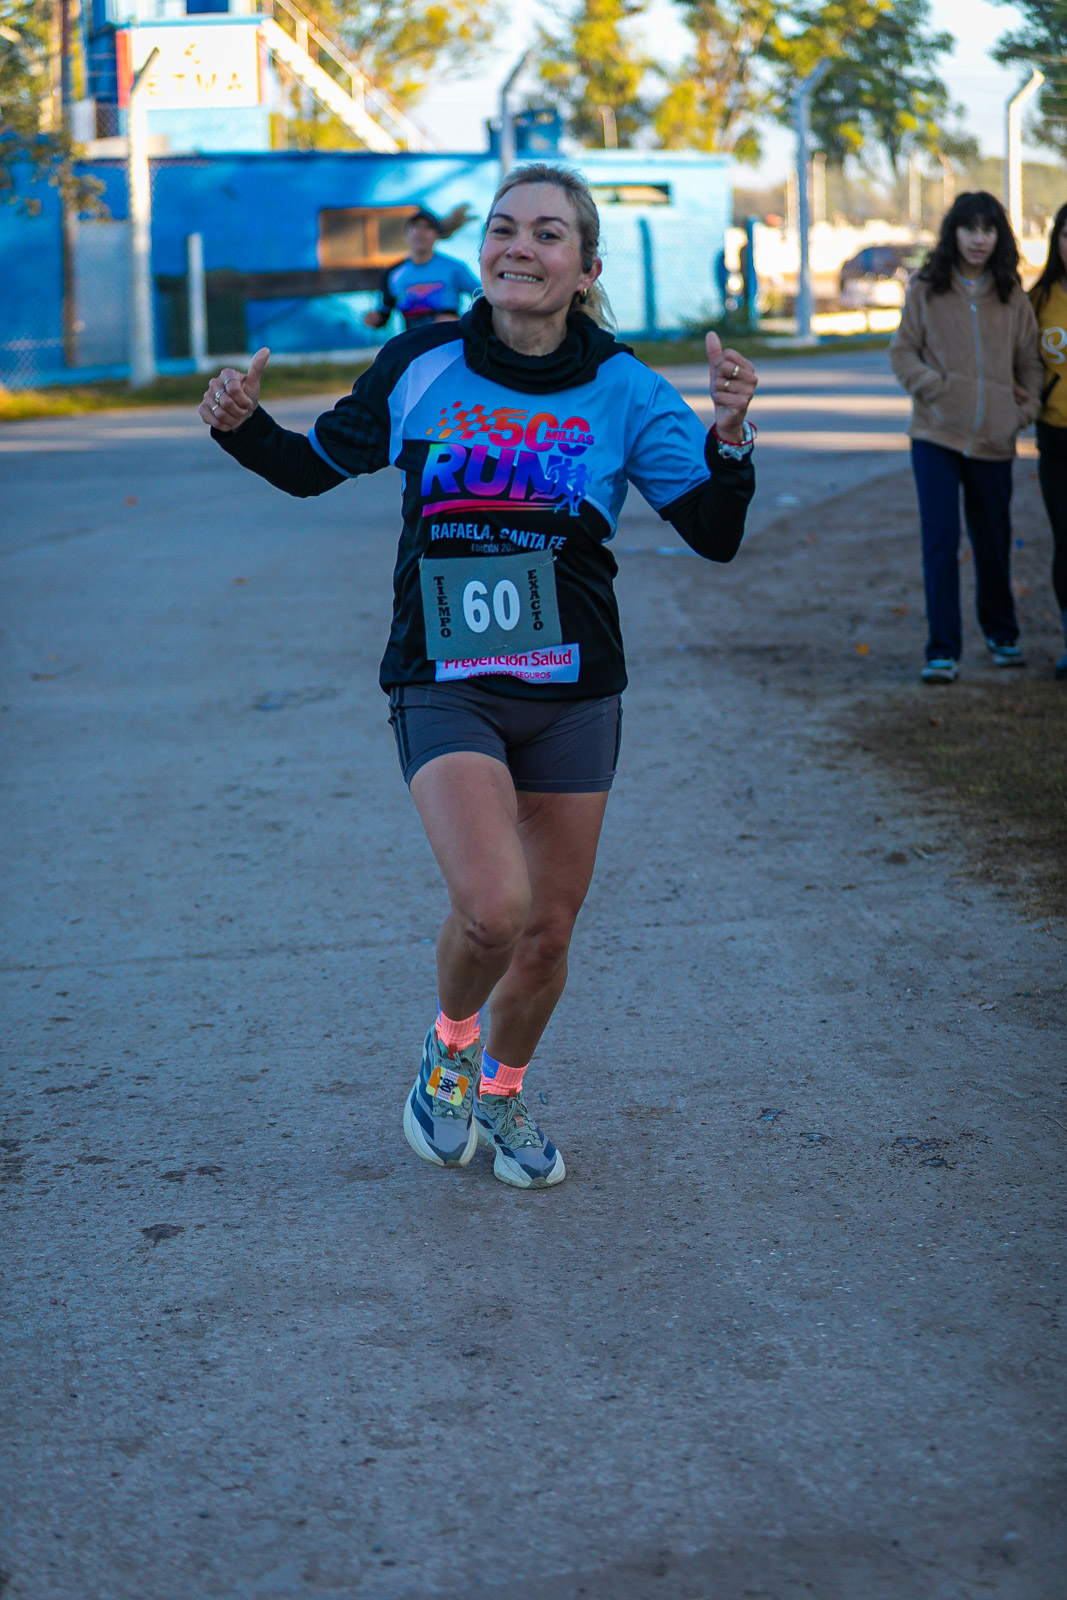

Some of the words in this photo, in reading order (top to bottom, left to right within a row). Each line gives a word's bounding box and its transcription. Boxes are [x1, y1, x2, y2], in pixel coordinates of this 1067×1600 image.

[487, 407, 590, 456] 500
[544, 430, 595, 446] MILLAS
[420, 443, 564, 500] RUN
[431, 522, 494, 541] RAFAELA,
[500, 527, 546, 549] SANTA
[546, 535, 567, 550] FE
[433, 575, 451, 638] TIEMPO
[462, 579, 521, 633] 60
[527, 569, 543, 631] EXACTO
[514, 671, 552, 680] SEGUROS
[531, 649, 572, 667] Salud
